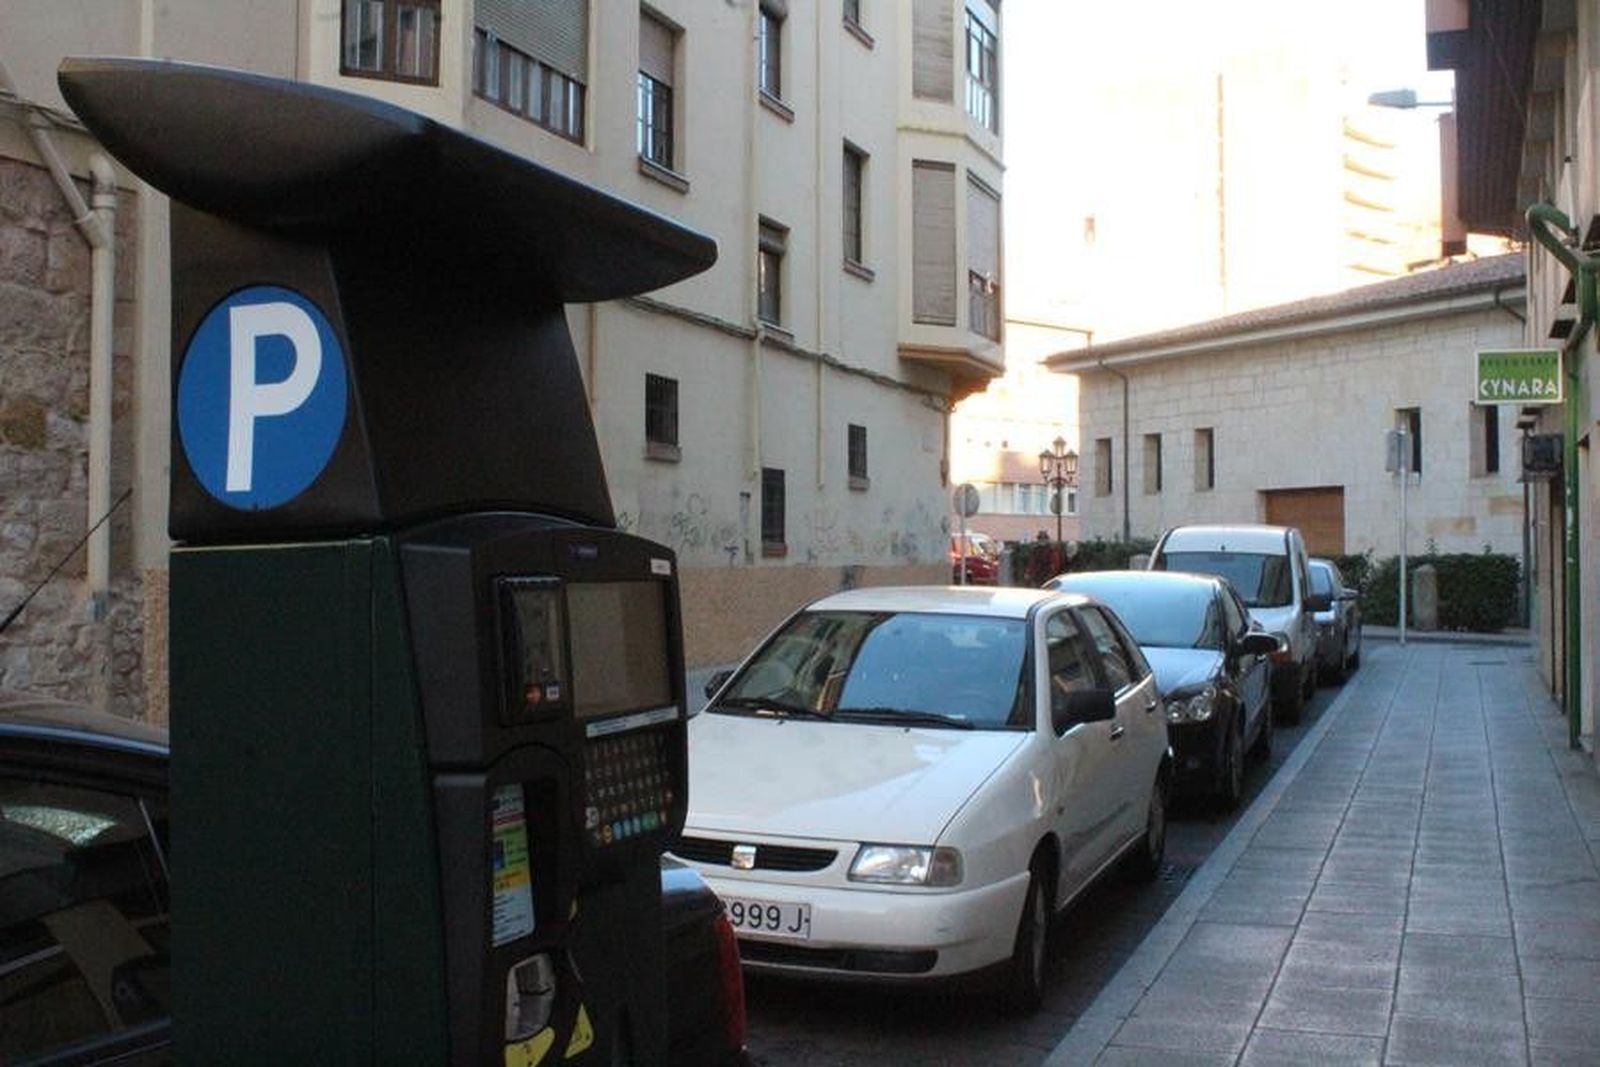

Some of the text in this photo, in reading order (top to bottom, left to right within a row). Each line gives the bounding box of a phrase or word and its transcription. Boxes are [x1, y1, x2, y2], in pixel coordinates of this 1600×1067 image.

[225, 302, 322, 492] P
[1480, 378, 1557, 396] CYNARA
[720, 901, 802, 933] 999 J
